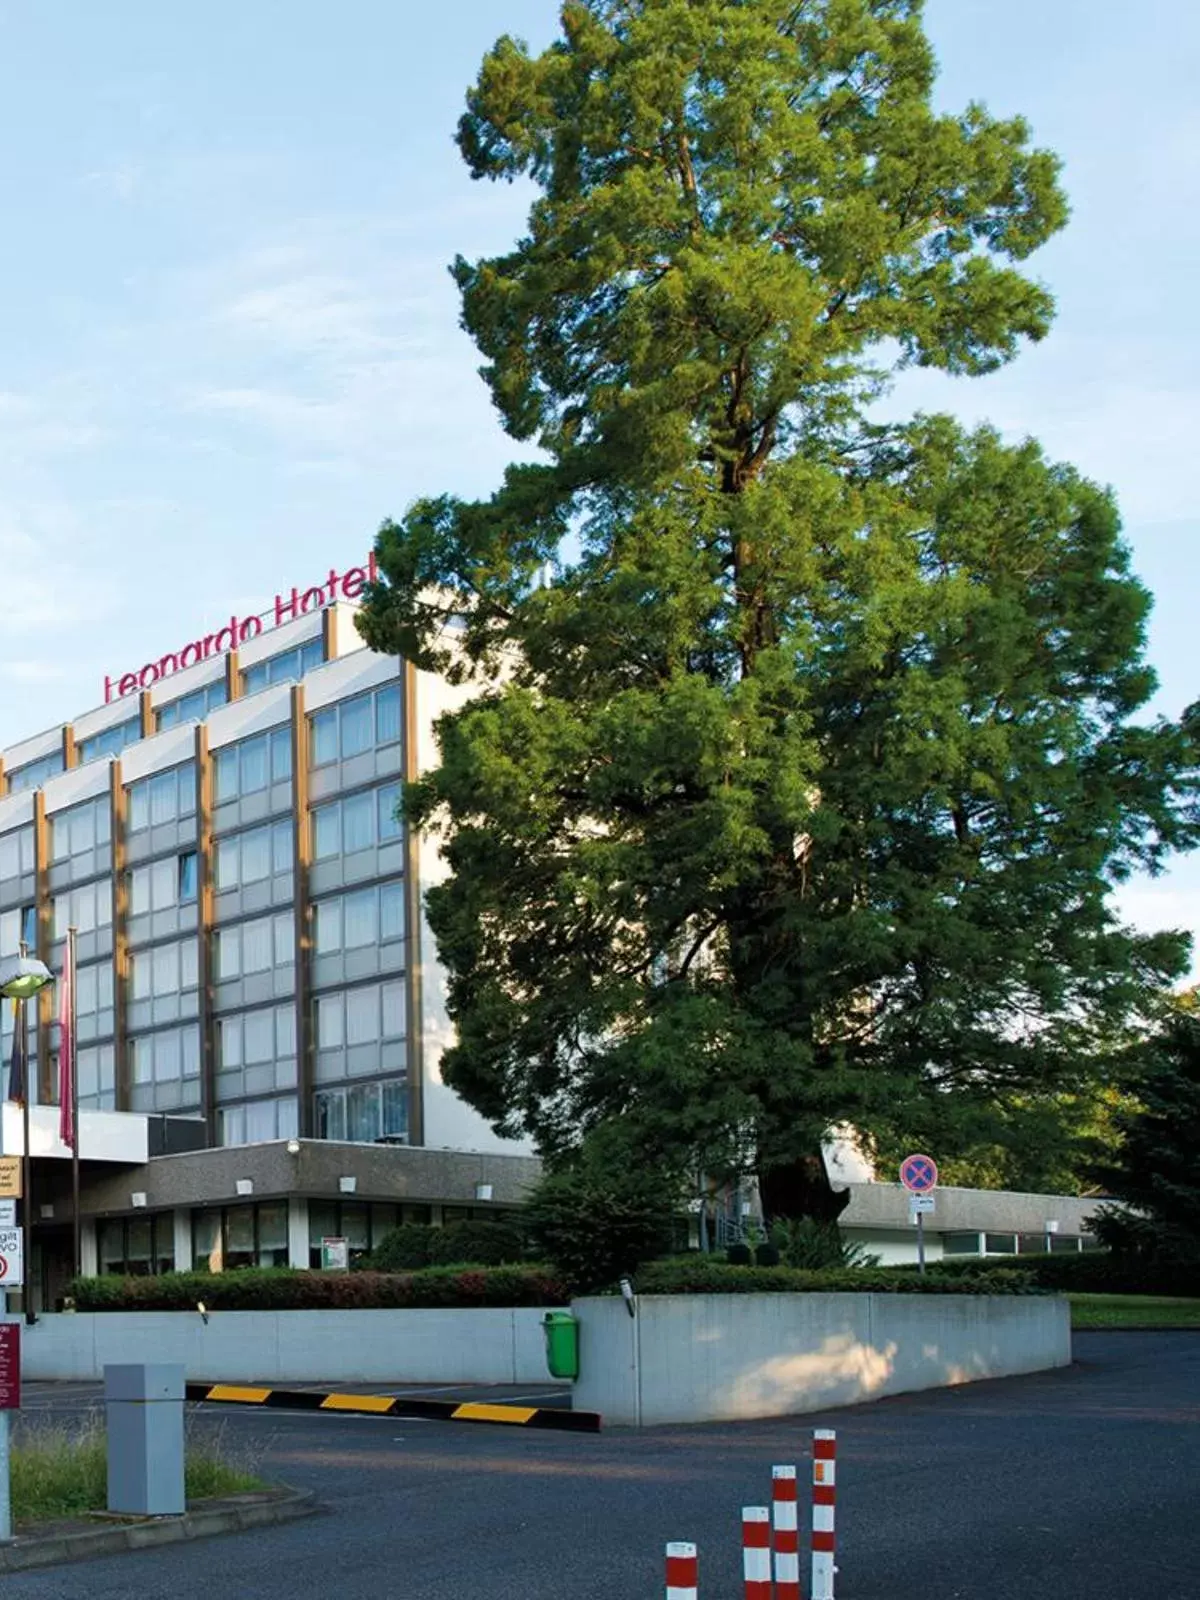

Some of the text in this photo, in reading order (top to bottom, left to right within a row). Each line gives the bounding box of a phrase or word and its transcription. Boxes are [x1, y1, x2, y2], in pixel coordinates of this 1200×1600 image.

[104, 551, 377, 703] Leonardo Hotel
[0, 1231, 17, 1244] gilt
